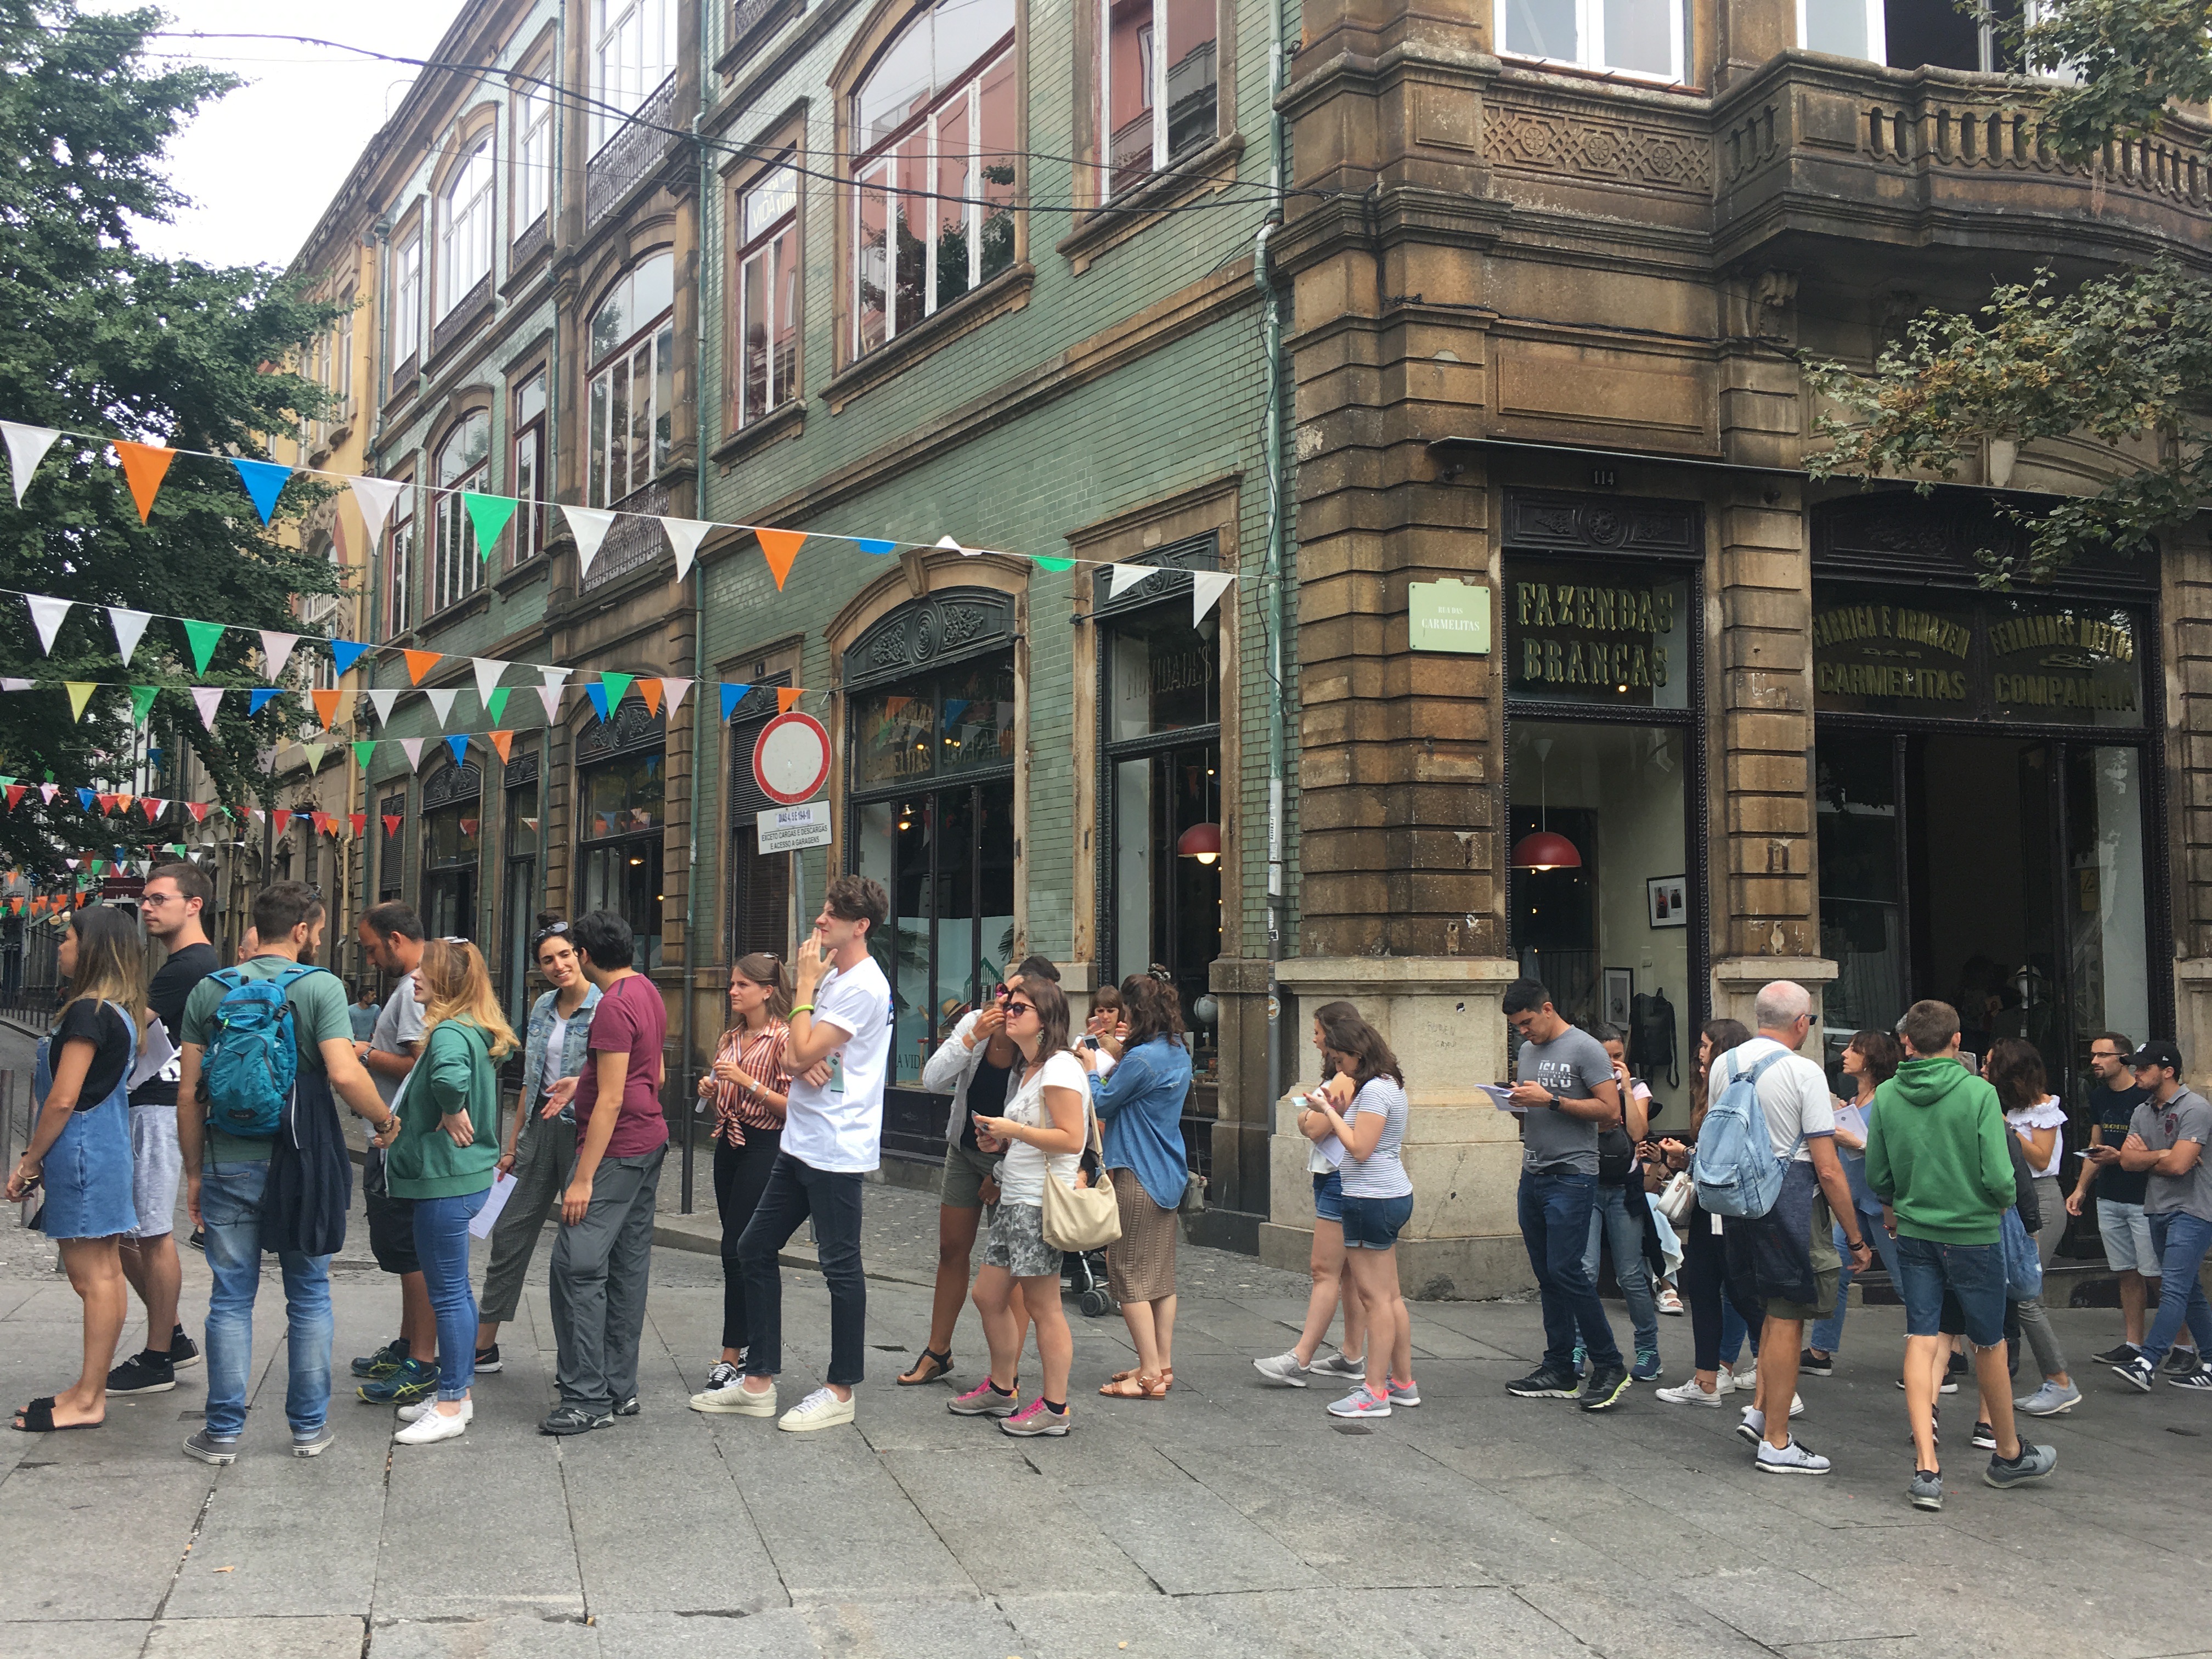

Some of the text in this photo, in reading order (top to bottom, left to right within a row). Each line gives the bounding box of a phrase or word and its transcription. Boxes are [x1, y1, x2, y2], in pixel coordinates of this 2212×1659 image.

[763, 177, 778, 198] VIDA
[753, 185, 797, 228] VIDA VIDA
[1594, 470, 1615, 485] 114
[1516, 582, 1673, 633] FAZENDAS
[1421, 618, 1480, 631] CARMELITAS
[1881, 606, 1891, 639] E
[1522, 637, 1668, 687] BRANCAS
[1816, 662, 1966, 702] CARMELITAS
[761, 833, 778, 842] EXCETO
[779, 830, 797, 838] CARGAS
[801, 825, 828, 836] DESCARGAS
[774, 840, 791, 849] ACESSO
[795, 836, 820, 846] GARAGENS
[905, 1054, 926, 1069] VIDA
